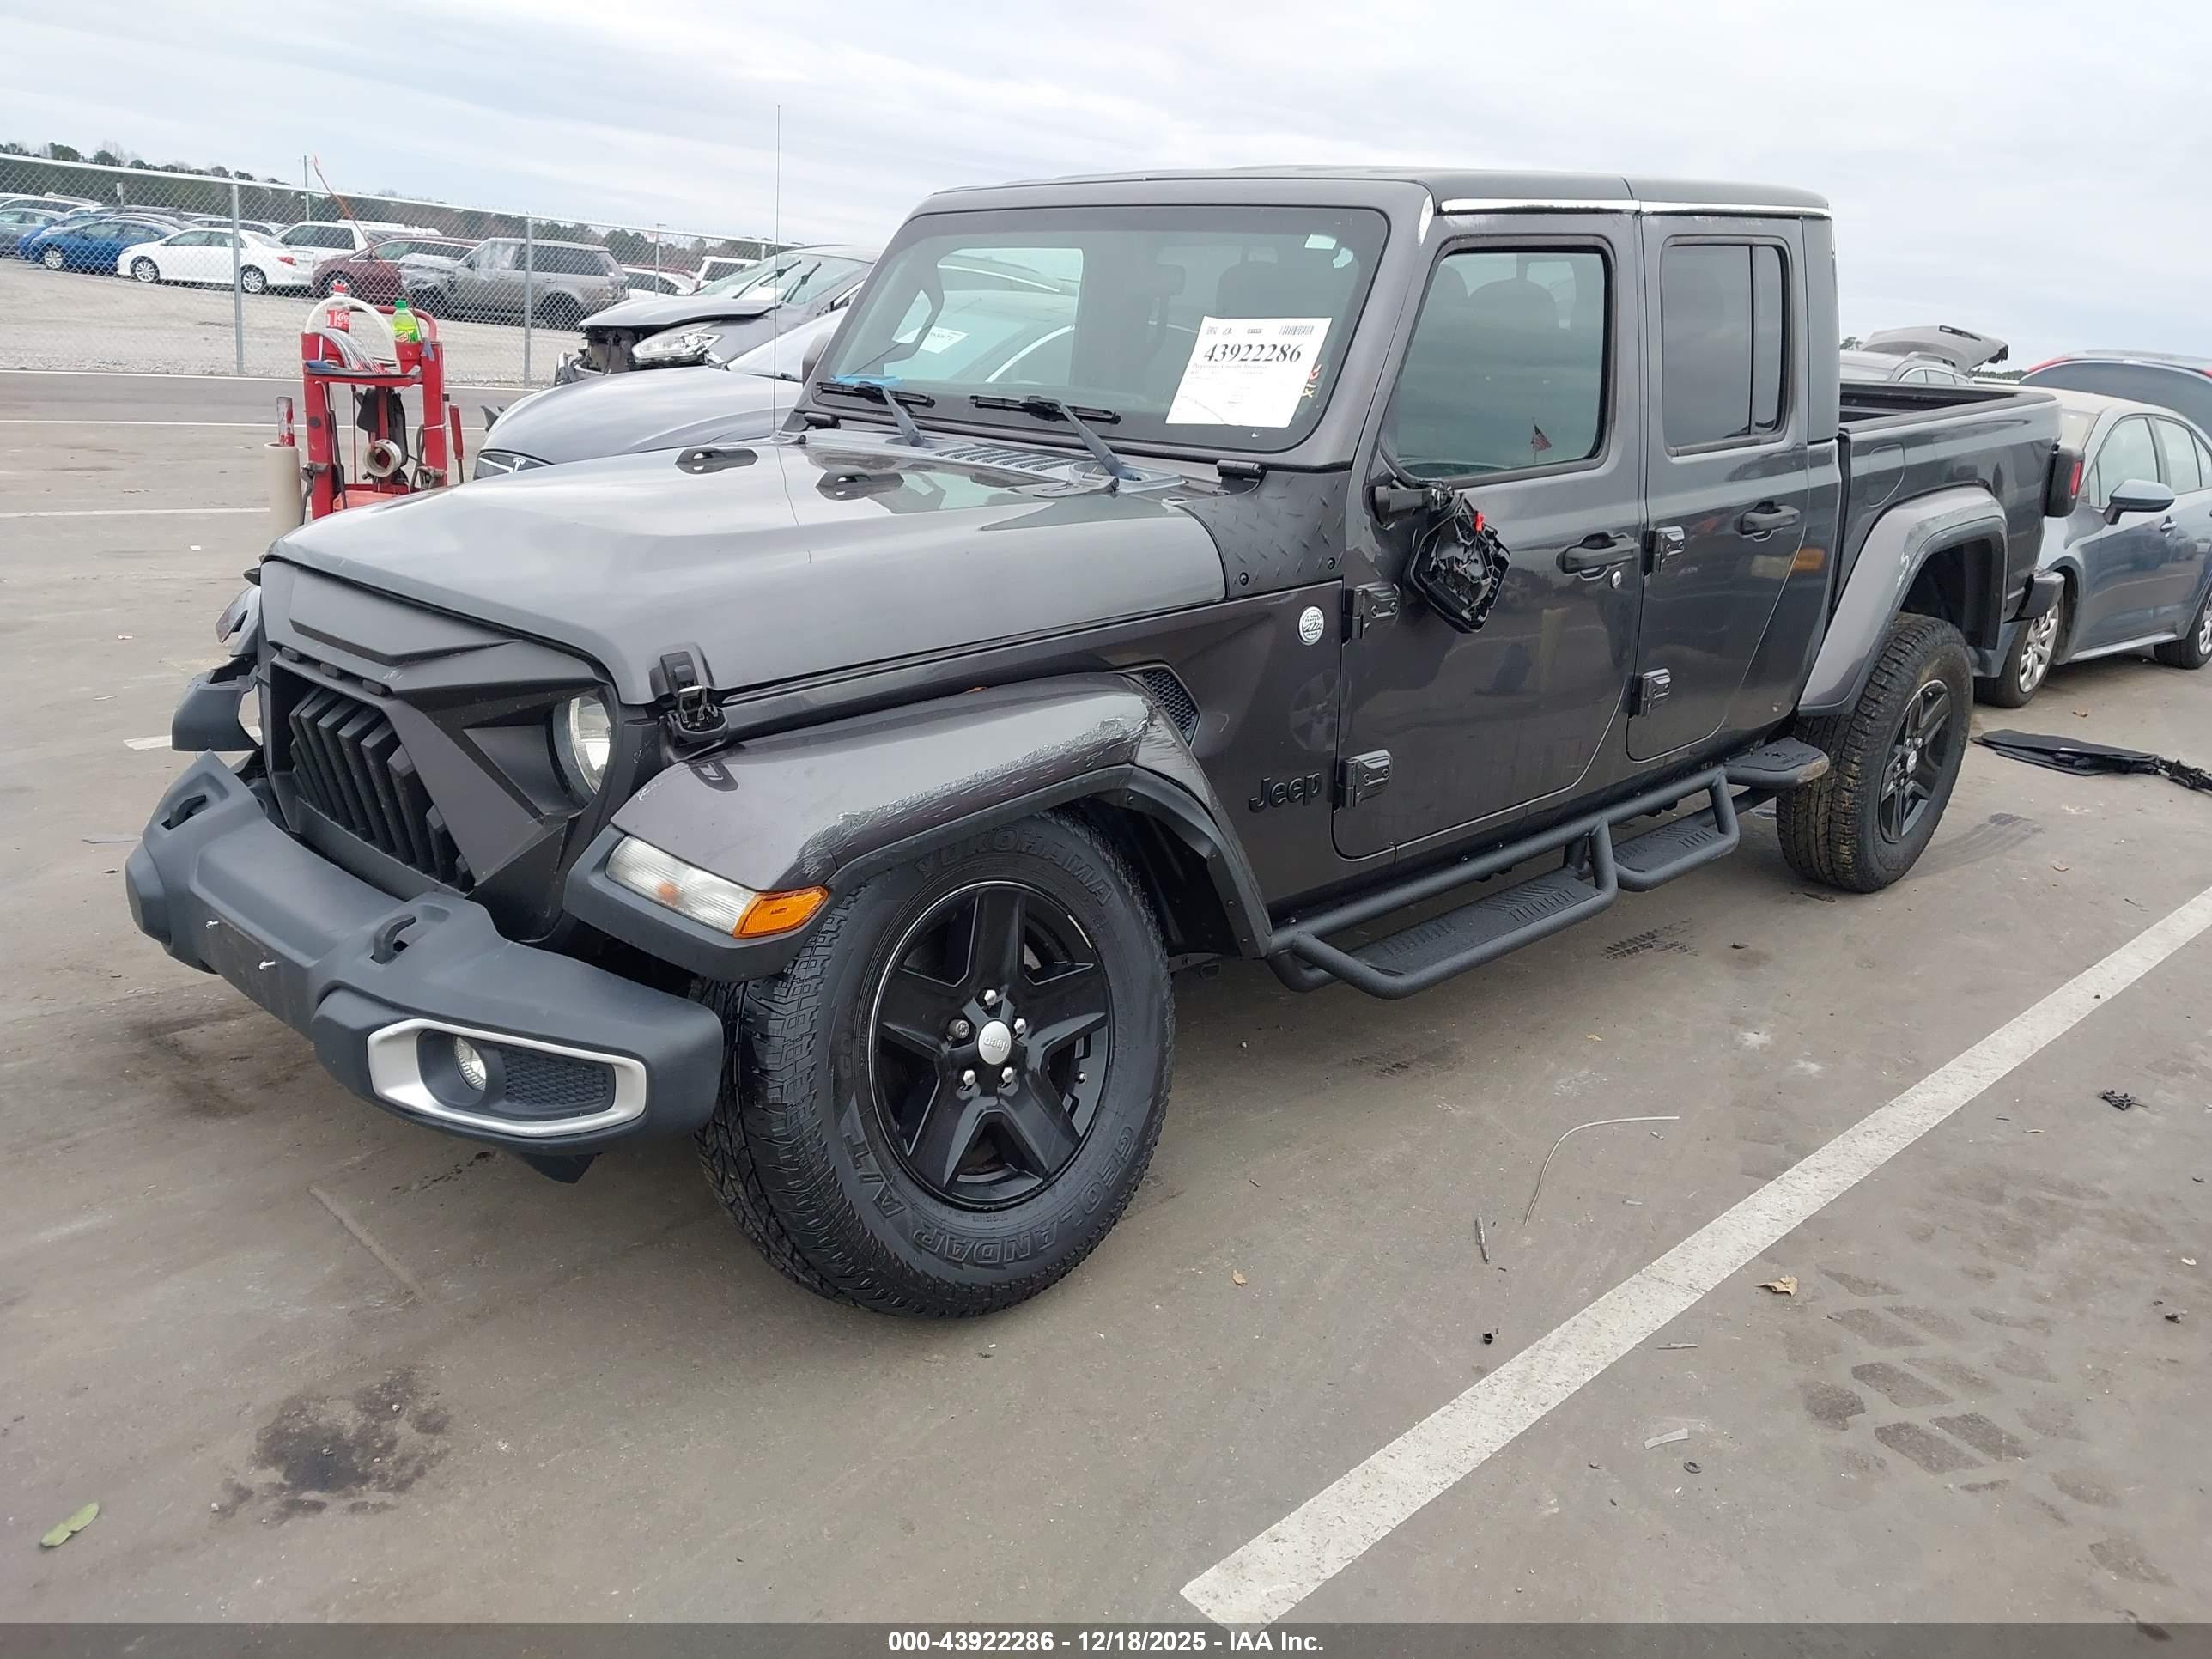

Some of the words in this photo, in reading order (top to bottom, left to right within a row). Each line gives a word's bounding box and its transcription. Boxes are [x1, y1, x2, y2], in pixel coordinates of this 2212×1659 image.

[1204, 343, 1305, 362] 43922286
[1248, 771, 1322, 813] Jeep
[913, 824, 1114, 907] YOKOHAMA
[982, 1034, 1009, 1053] Jeep
